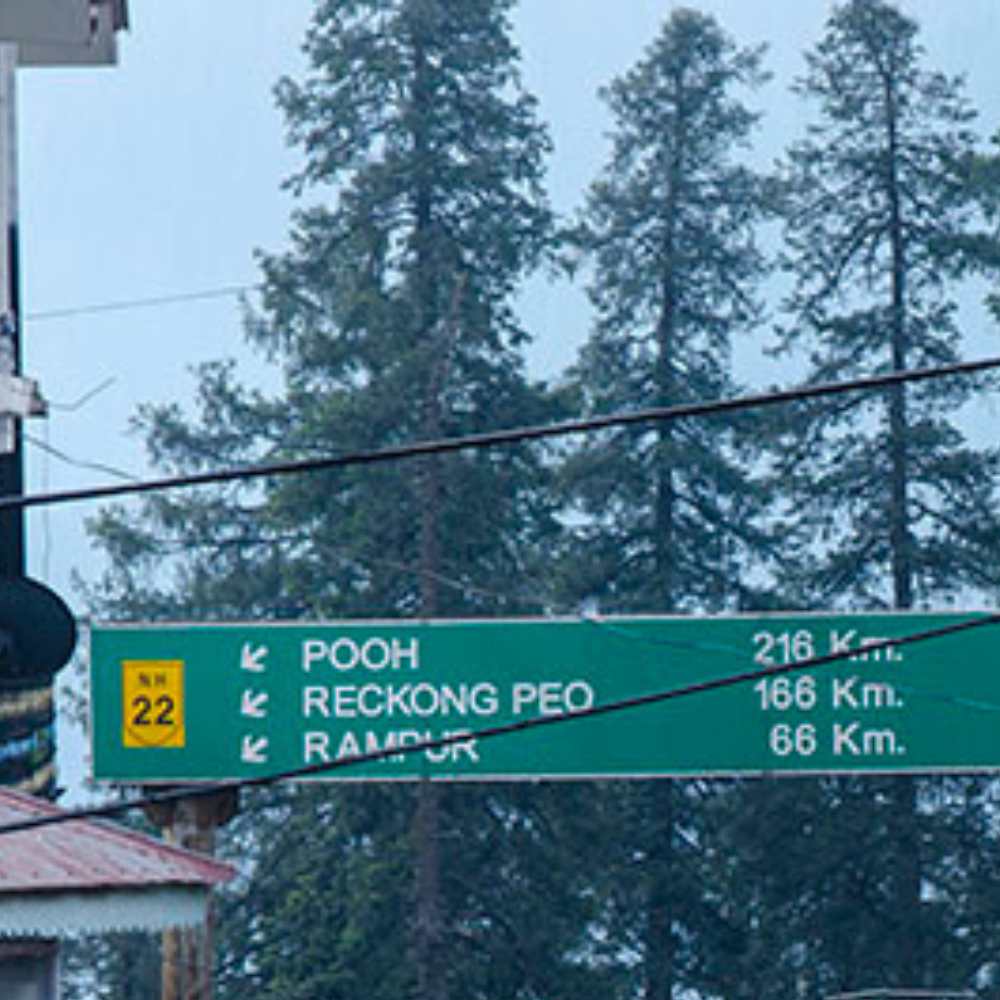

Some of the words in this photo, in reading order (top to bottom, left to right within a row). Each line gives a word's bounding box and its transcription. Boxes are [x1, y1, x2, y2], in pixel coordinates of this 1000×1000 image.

[302, 637, 419, 671] POOH
[753, 630, 816, 665] 216
[829, 629, 903, 661] Km.
[131, 694, 175, 726] 22
[302, 682, 498, 718] RECKONG
[511, 681, 595, 715] PEO
[754, 675, 816, 710] 166
[832, 678, 904, 709] Km.
[303, 728, 480, 764] RAMPUR
[770, 723, 816, 756] 66
[832, 721, 905, 756] Km.
